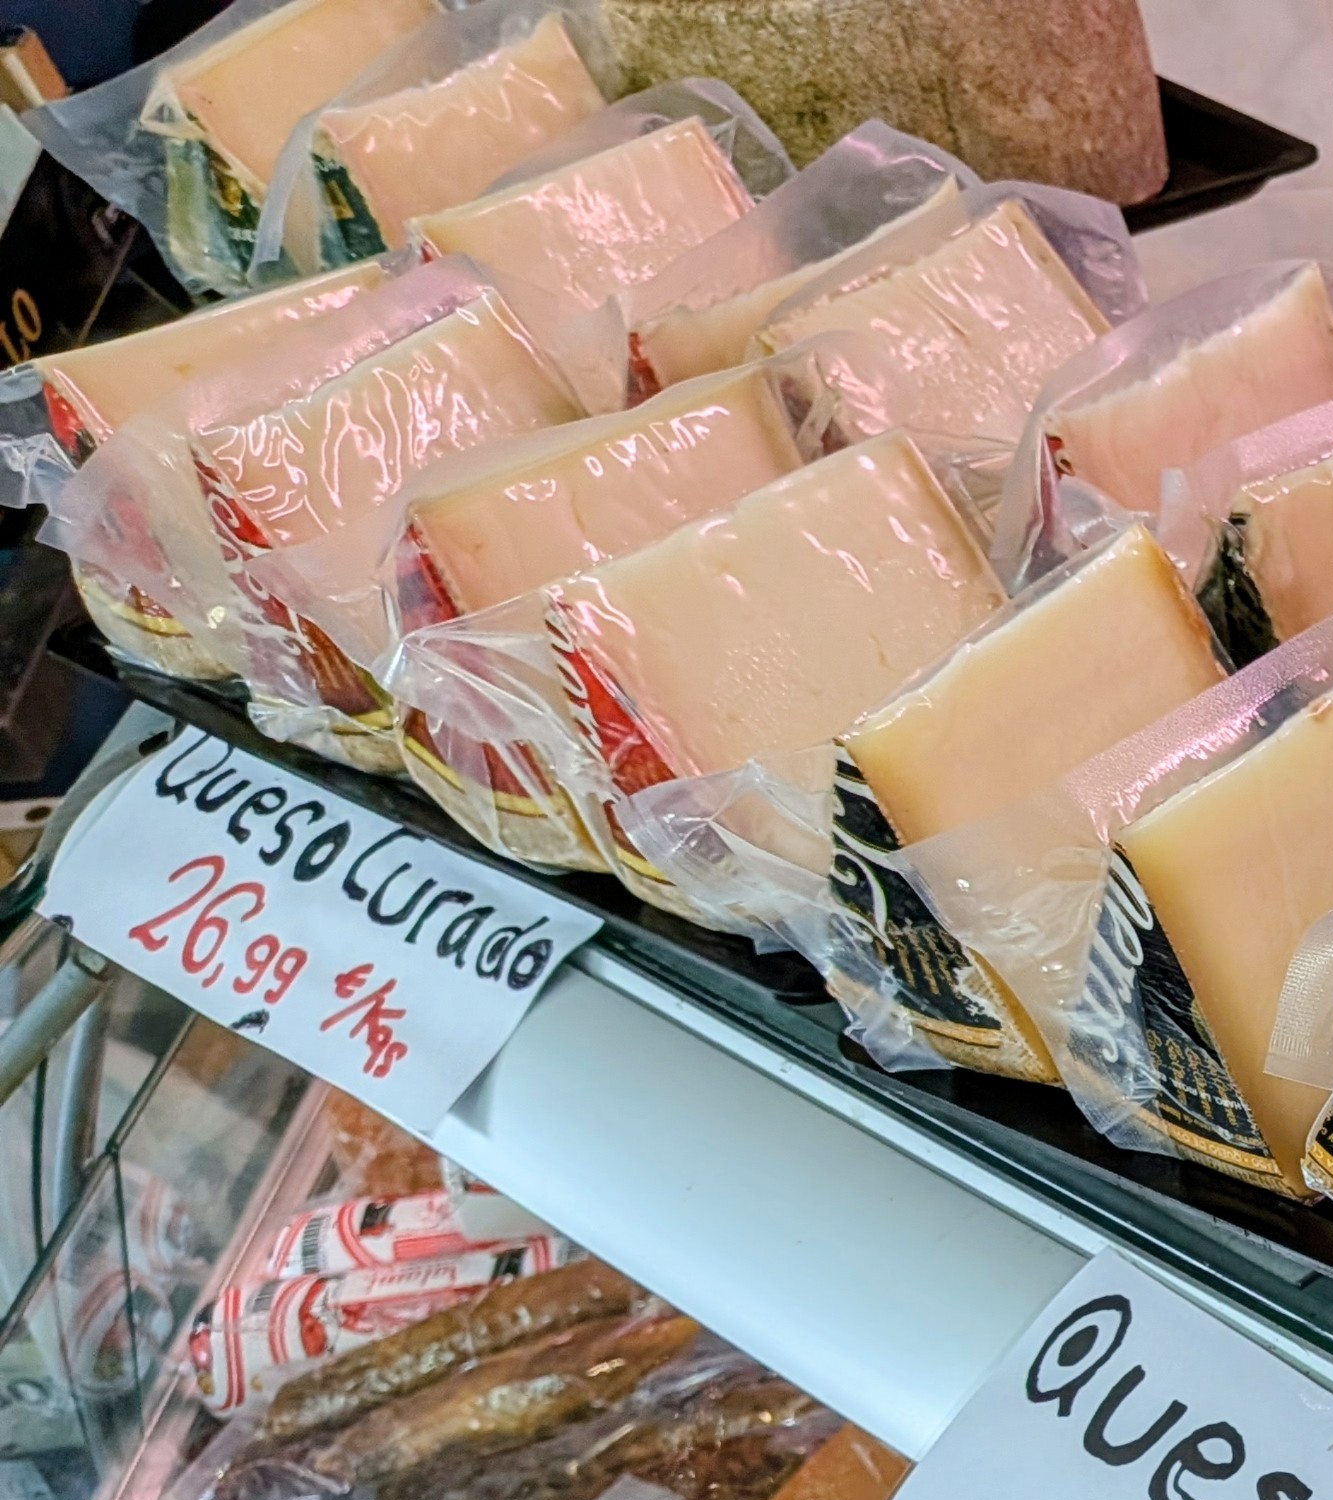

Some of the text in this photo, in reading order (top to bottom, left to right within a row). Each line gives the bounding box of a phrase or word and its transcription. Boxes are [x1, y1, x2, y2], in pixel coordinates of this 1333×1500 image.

[128, 855, 308, 1004] 26,99
[156, 733, 554, 990] Queso Curado
